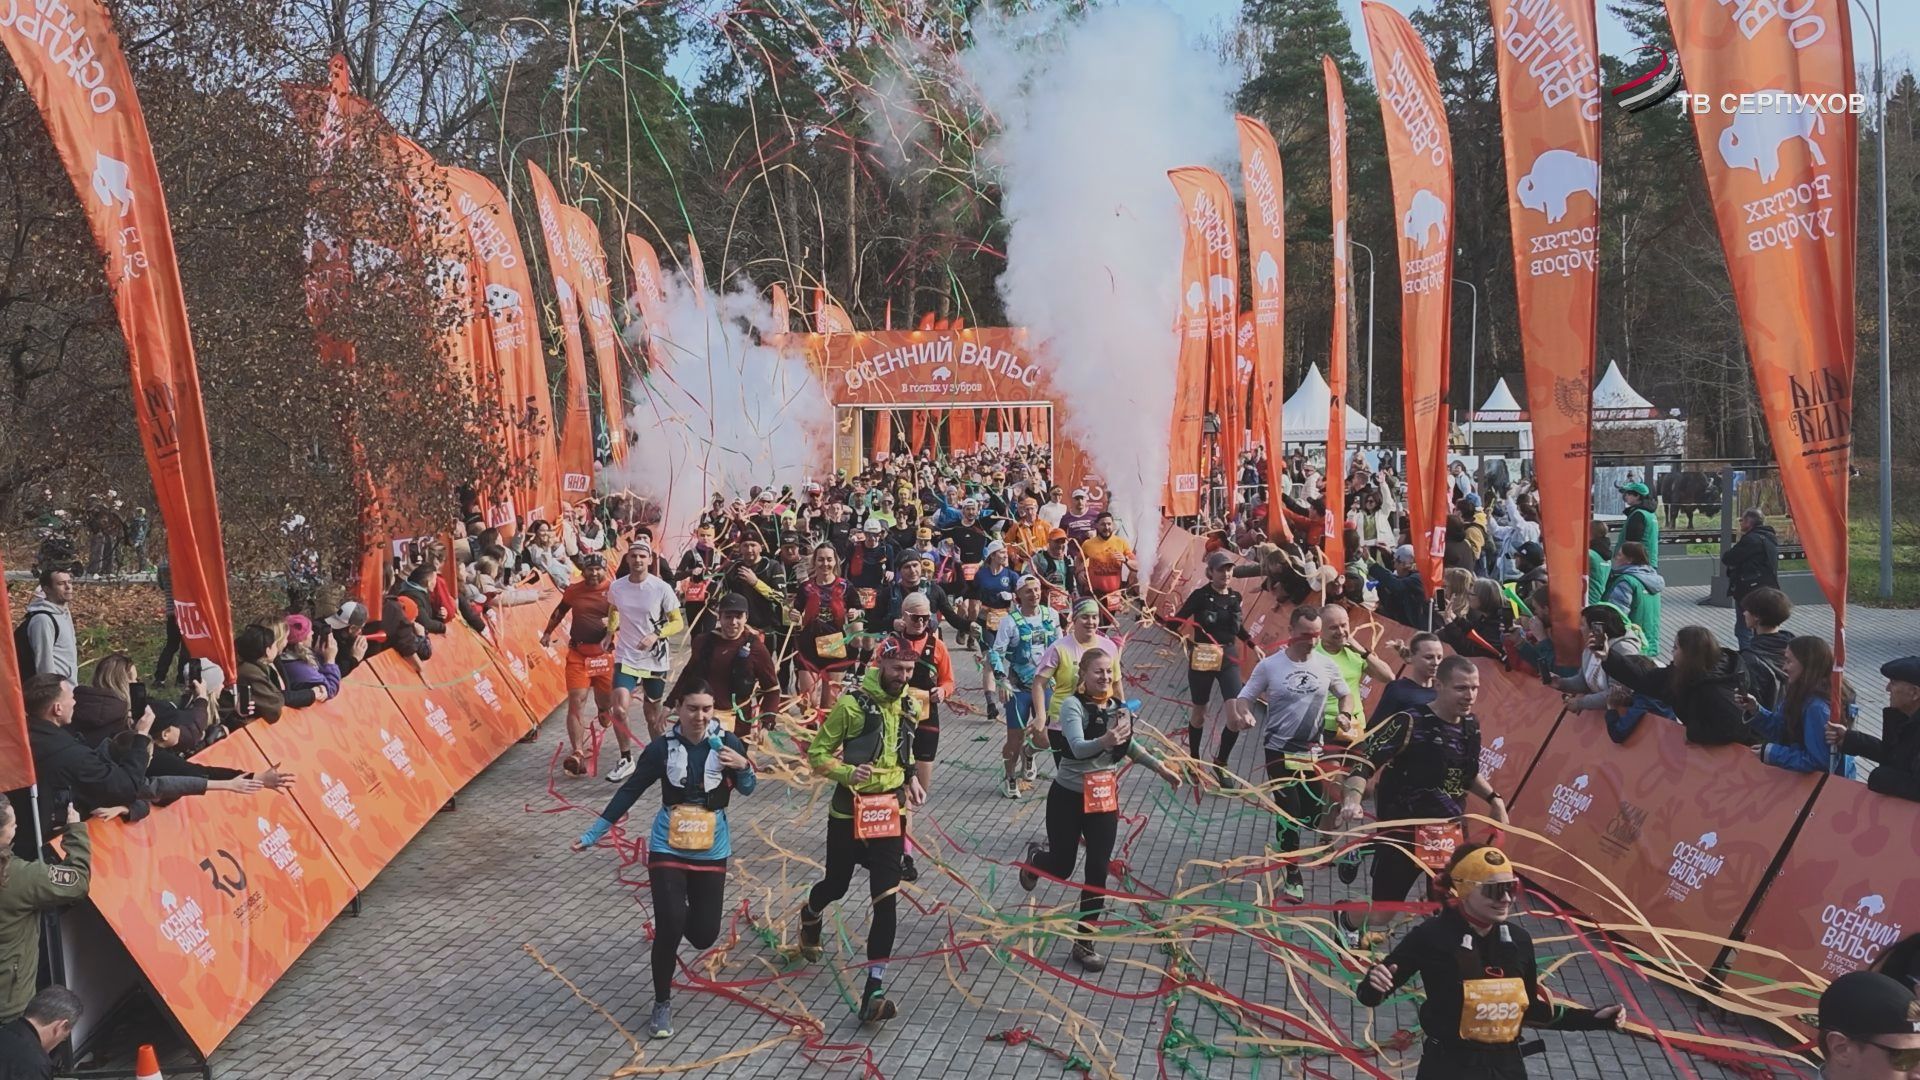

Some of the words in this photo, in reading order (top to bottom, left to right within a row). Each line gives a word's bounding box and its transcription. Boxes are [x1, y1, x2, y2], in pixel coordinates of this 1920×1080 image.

[845, 335, 952, 389] ОСЕННИЙ
[960, 342, 1042, 387] ВАЛЬС
[901, 383, 908, 393] В
[909, 384, 941, 393] гостях
[942, 383, 948, 396] у
[949, 381, 982, 395] зубров
[1548, 799, 1580, 825] ВАЛЬС
[1552, 783, 1594, 812] ОСЕННИЙ
[1668, 859, 1707, 890] ВАЛЬС
[1672, 841, 1725, 877] ОСЕННИЙ
[160, 895, 203, 942] ОСЕННИЙ
[1821, 904, 1901, 946] ОСЕННИЙ
[176, 919, 210, 954] ВАЛЬС
[1821, 926, 1880, 964] ВАЛЬС
